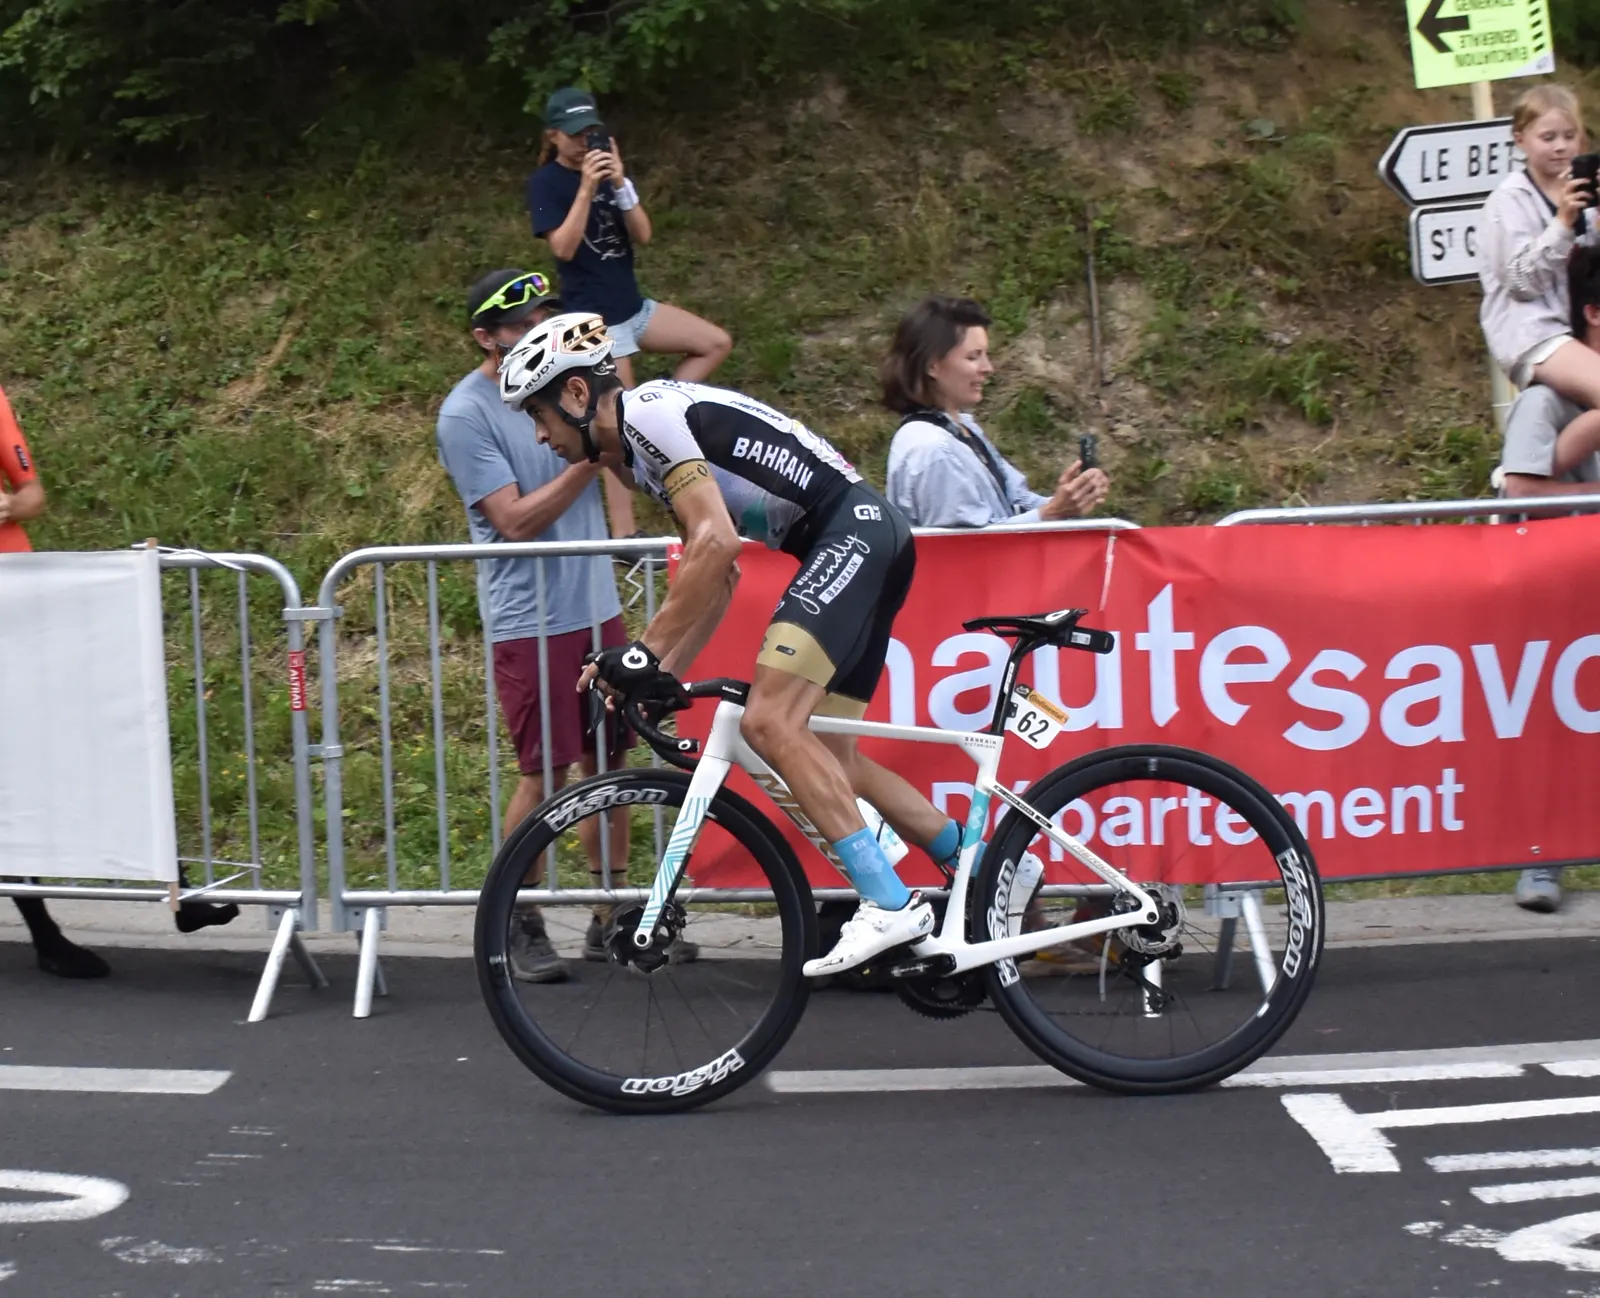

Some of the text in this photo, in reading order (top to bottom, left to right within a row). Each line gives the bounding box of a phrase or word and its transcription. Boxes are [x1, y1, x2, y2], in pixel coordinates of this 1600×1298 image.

[1420, 148, 1449, 183] LE
[524, 356, 555, 391] RUDY
[624, 420, 672, 466] ERIDA
[732, 437, 814, 490] BAHRAIN
[789, 532, 871, 614] friendly
[796, 551, 827, 586] BUSINESS
[826, 560, 860, 598] BAHRAIN
[1017, 710, 1050, 743] 62
